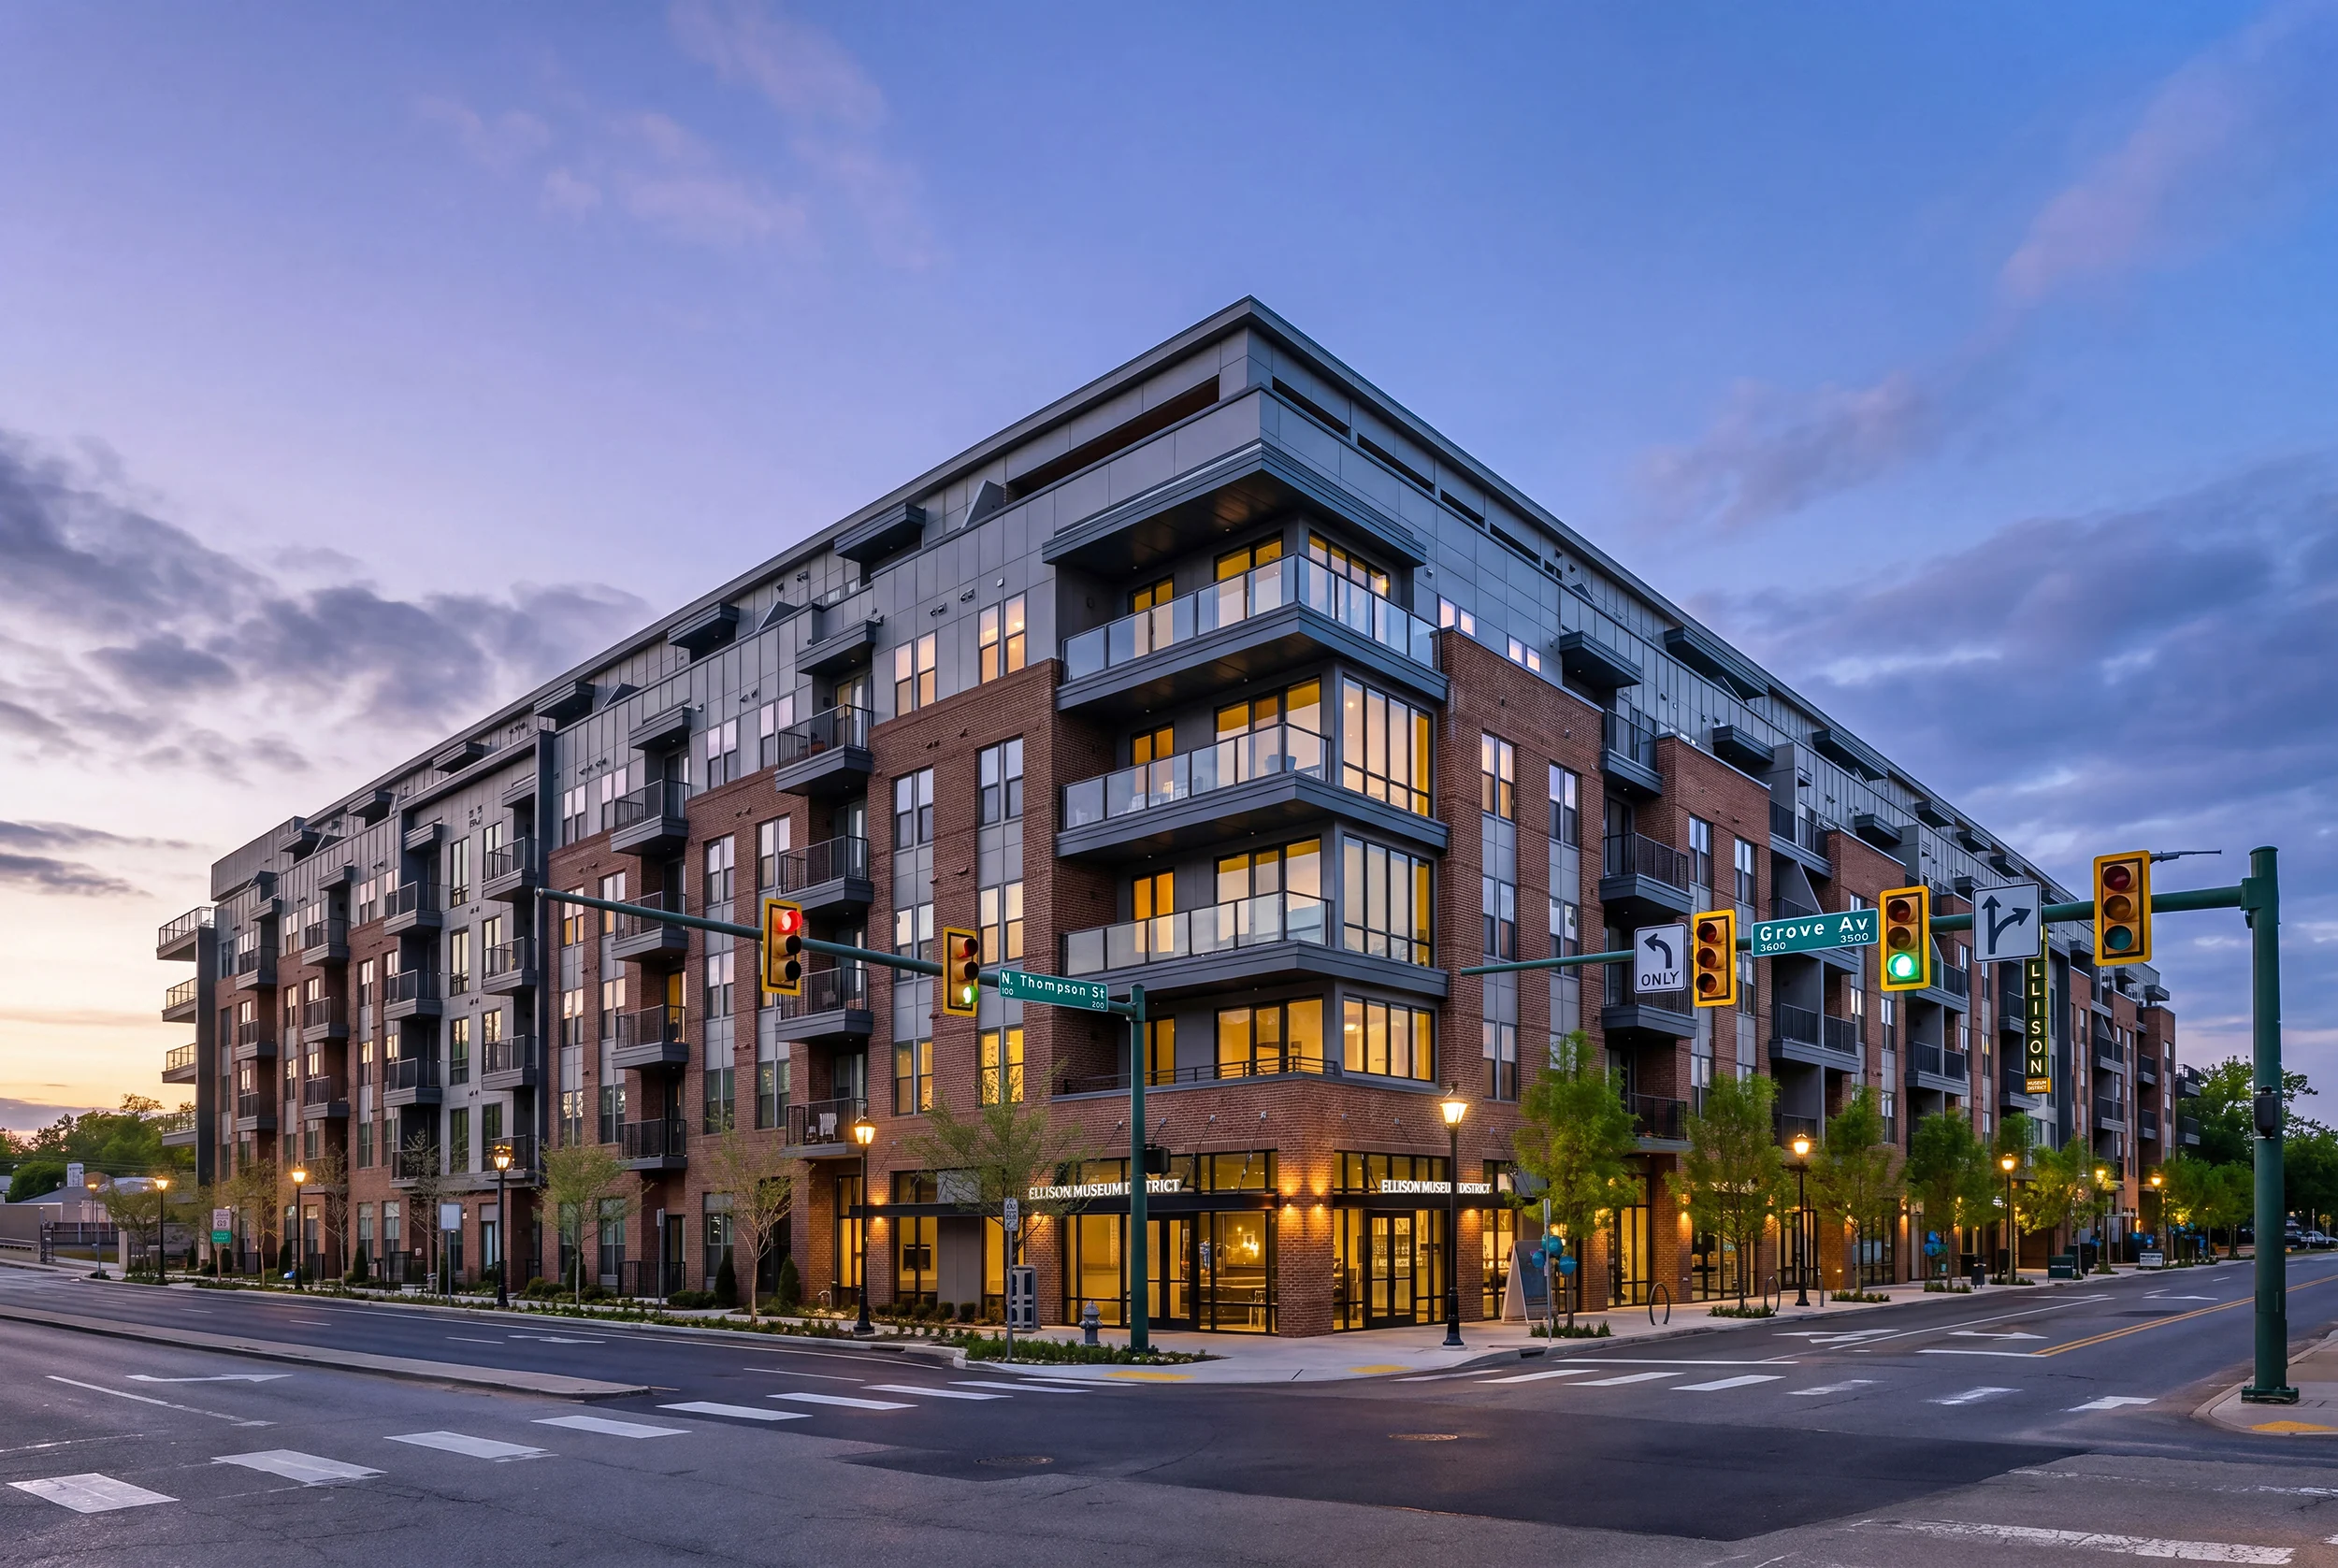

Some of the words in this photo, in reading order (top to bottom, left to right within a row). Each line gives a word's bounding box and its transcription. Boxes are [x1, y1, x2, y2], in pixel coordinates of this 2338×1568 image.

[1759, 923, 1825, 942] Grove
[1839, 916, 1869, 932] Av
[1840, 933, 1869, 943] 3500
[1760, 942, 1786, 952] 3600
[1002, 971, 1014, 985] N.
[1020, 975, 1086, 996] Thompson
[1091, 986, 1104, 999] St
[1641, 971, 1680, 986] ONLY
[1002, 987, 1014, 996] 100
[1091, 1000, 1104, 1009] 200
[2030, 964, 2042, 1073] LLISON
[1029, 1186, 1073, 1201] ELLISON
[1073, 1181, 1122, 1198] MUSEUM
[1124, 1178, 1180, 1195] DTRICT
[1380, 1179, 1422, 1193] ELLISON
[1422, 1181, 1460, 1194] MUSEU
[1459, 1182, 1492, 1194] DISTRICT
